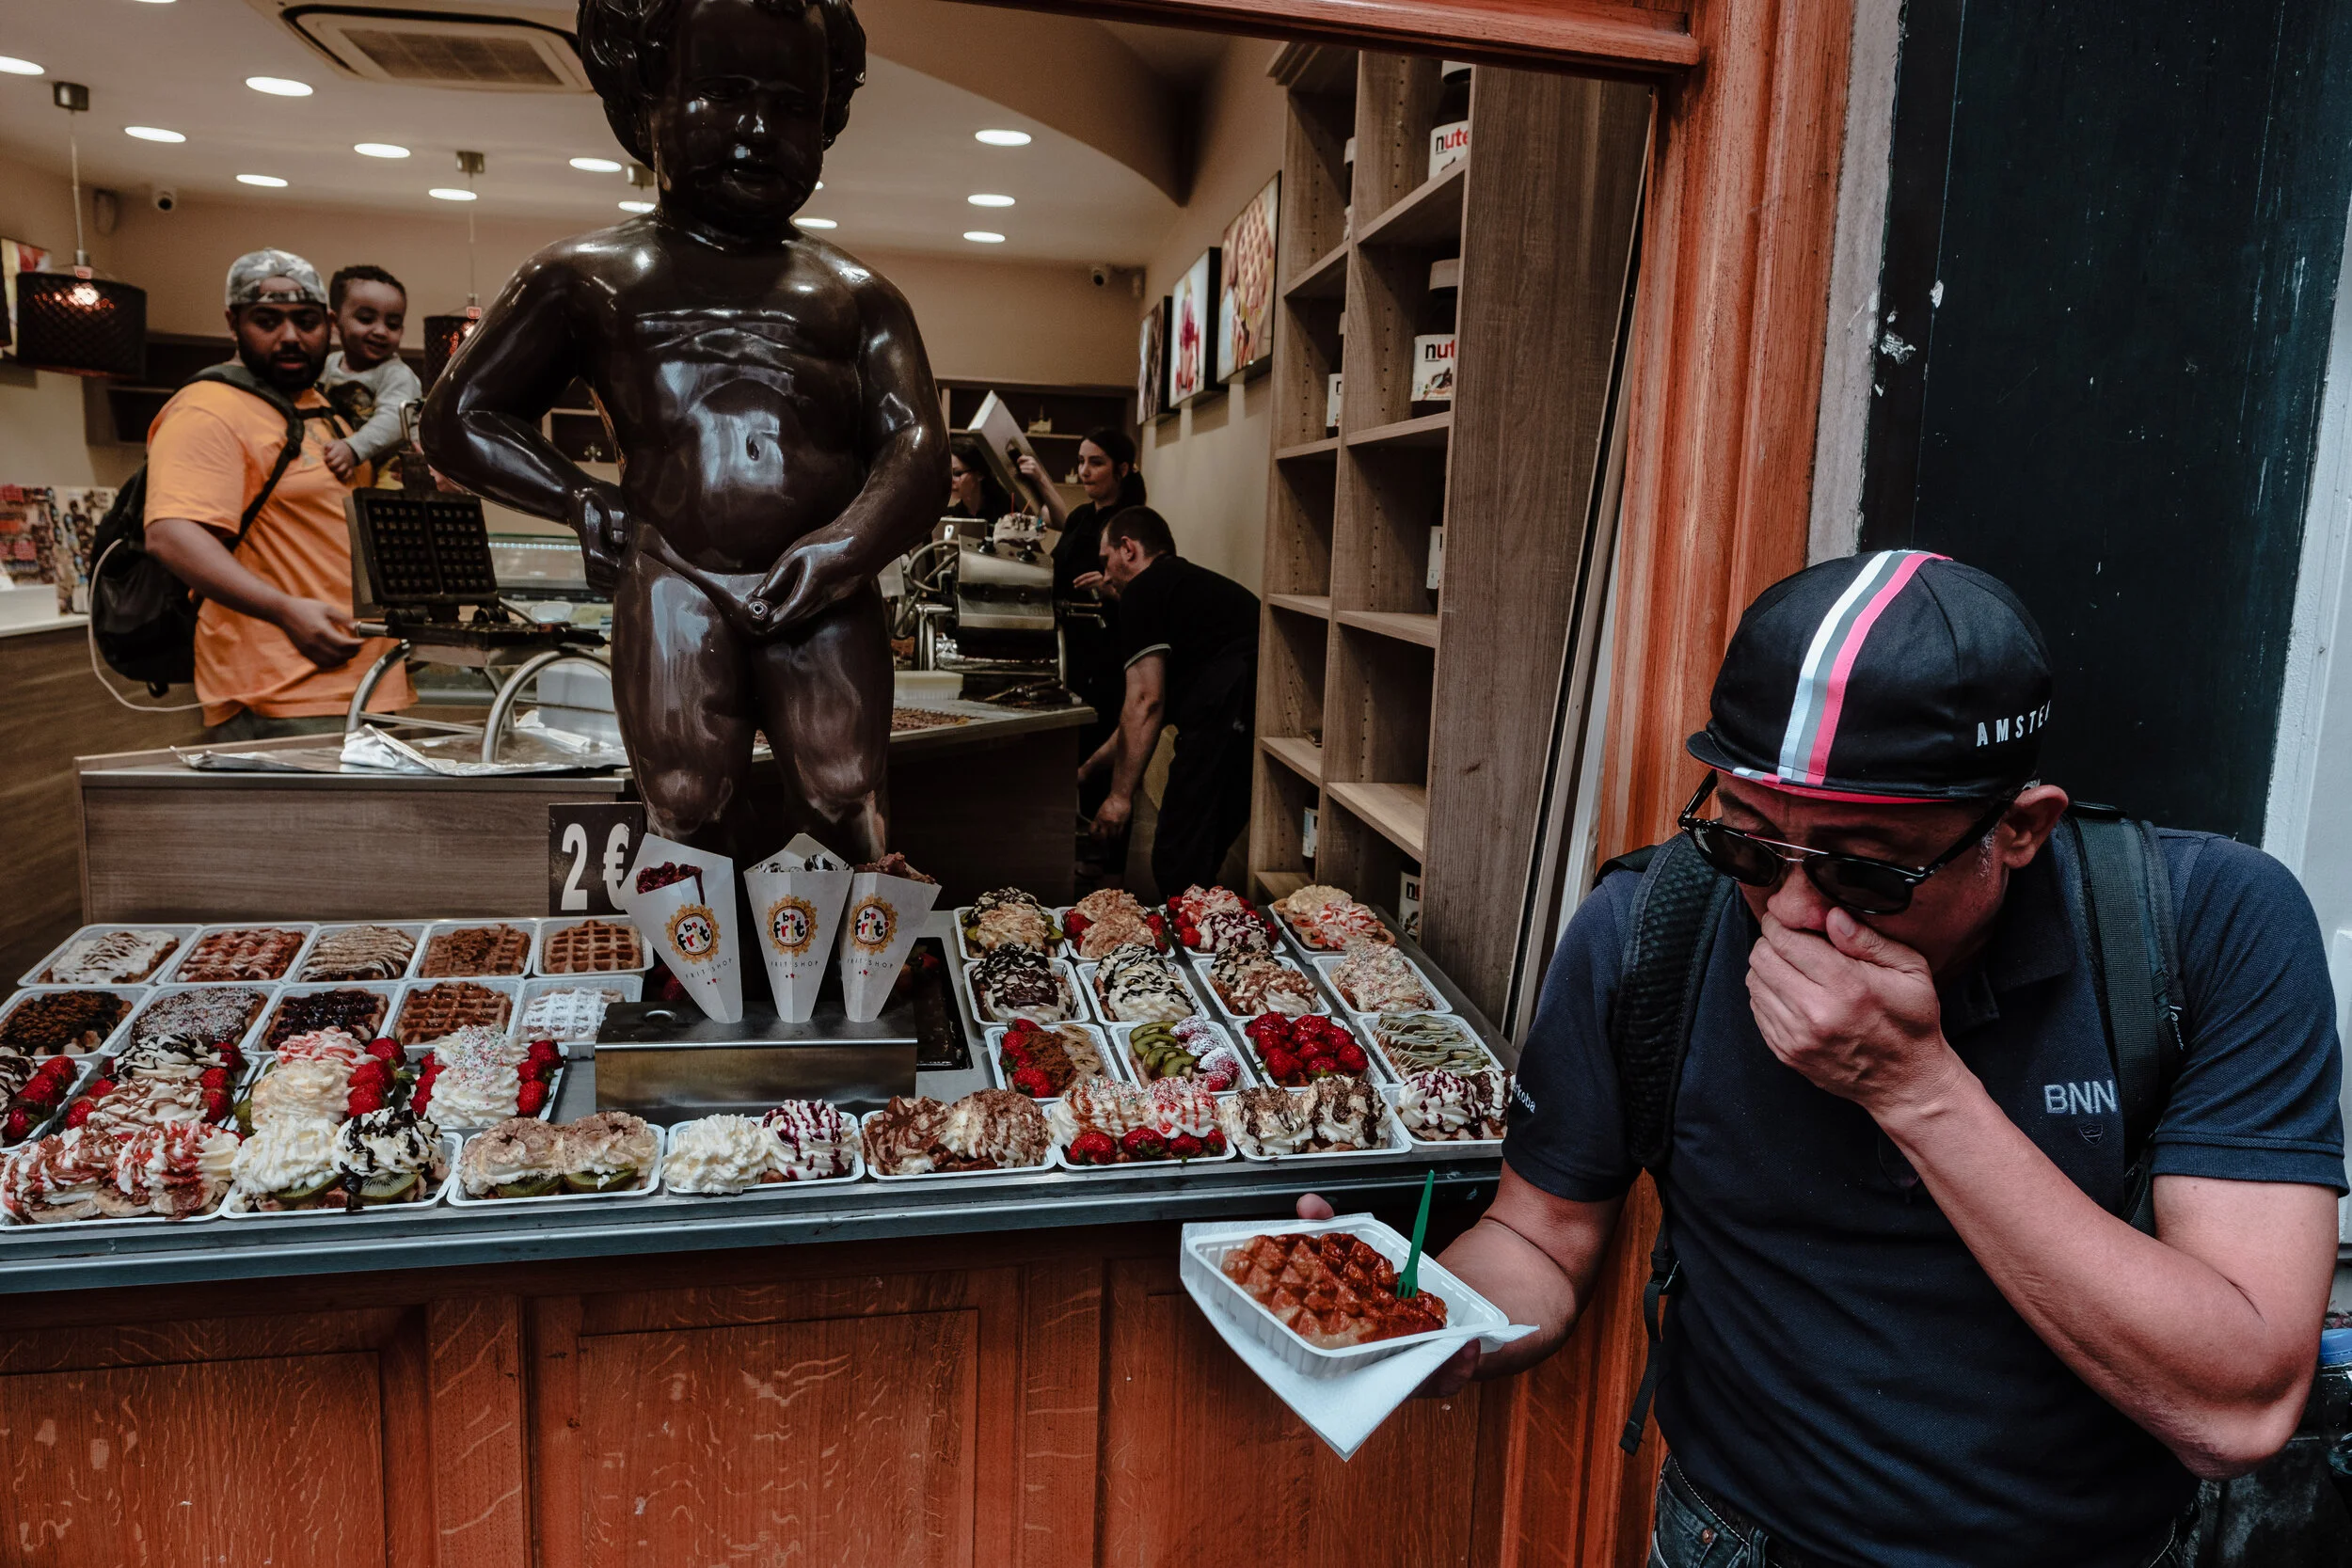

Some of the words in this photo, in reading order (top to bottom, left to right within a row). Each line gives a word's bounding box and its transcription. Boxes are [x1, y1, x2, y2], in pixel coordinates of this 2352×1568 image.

[561, 822, 588, 911] 2
[602, 822, 629, 911] €
[783, 912, 796, 922] be
[864, 911, 876, 920] be
[683, 922, 698, 932] be
[2043, 1079, 2120, 1115] BNN
